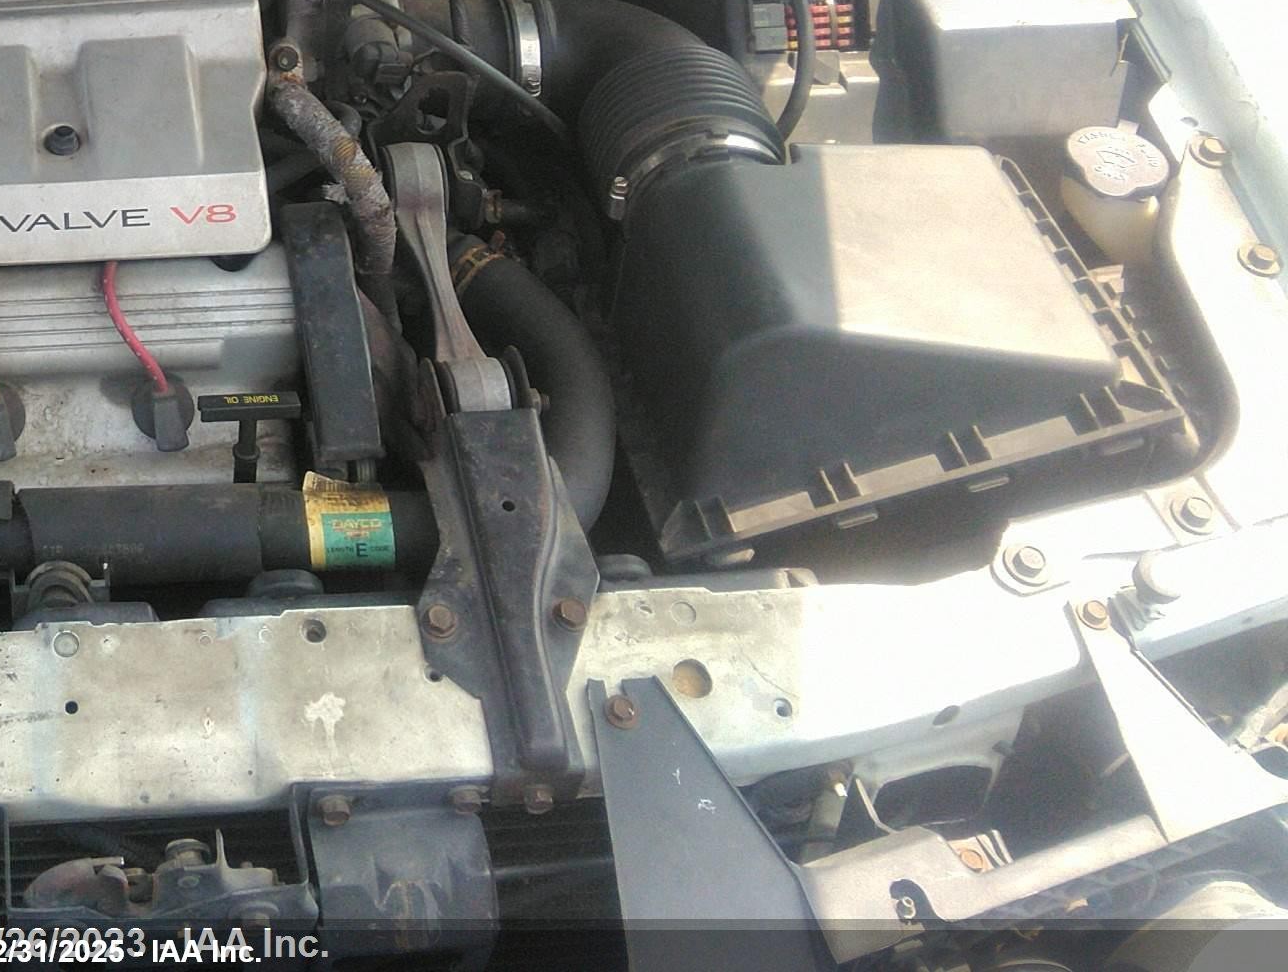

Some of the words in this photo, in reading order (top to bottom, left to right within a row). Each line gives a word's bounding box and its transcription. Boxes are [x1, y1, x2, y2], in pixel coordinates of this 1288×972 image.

[169, 203, 237, 226] V8
[224, 396, 239, 404] OIL
[242, 394, 279, 404] ENGINE
[356, 543, 369, 557] E
